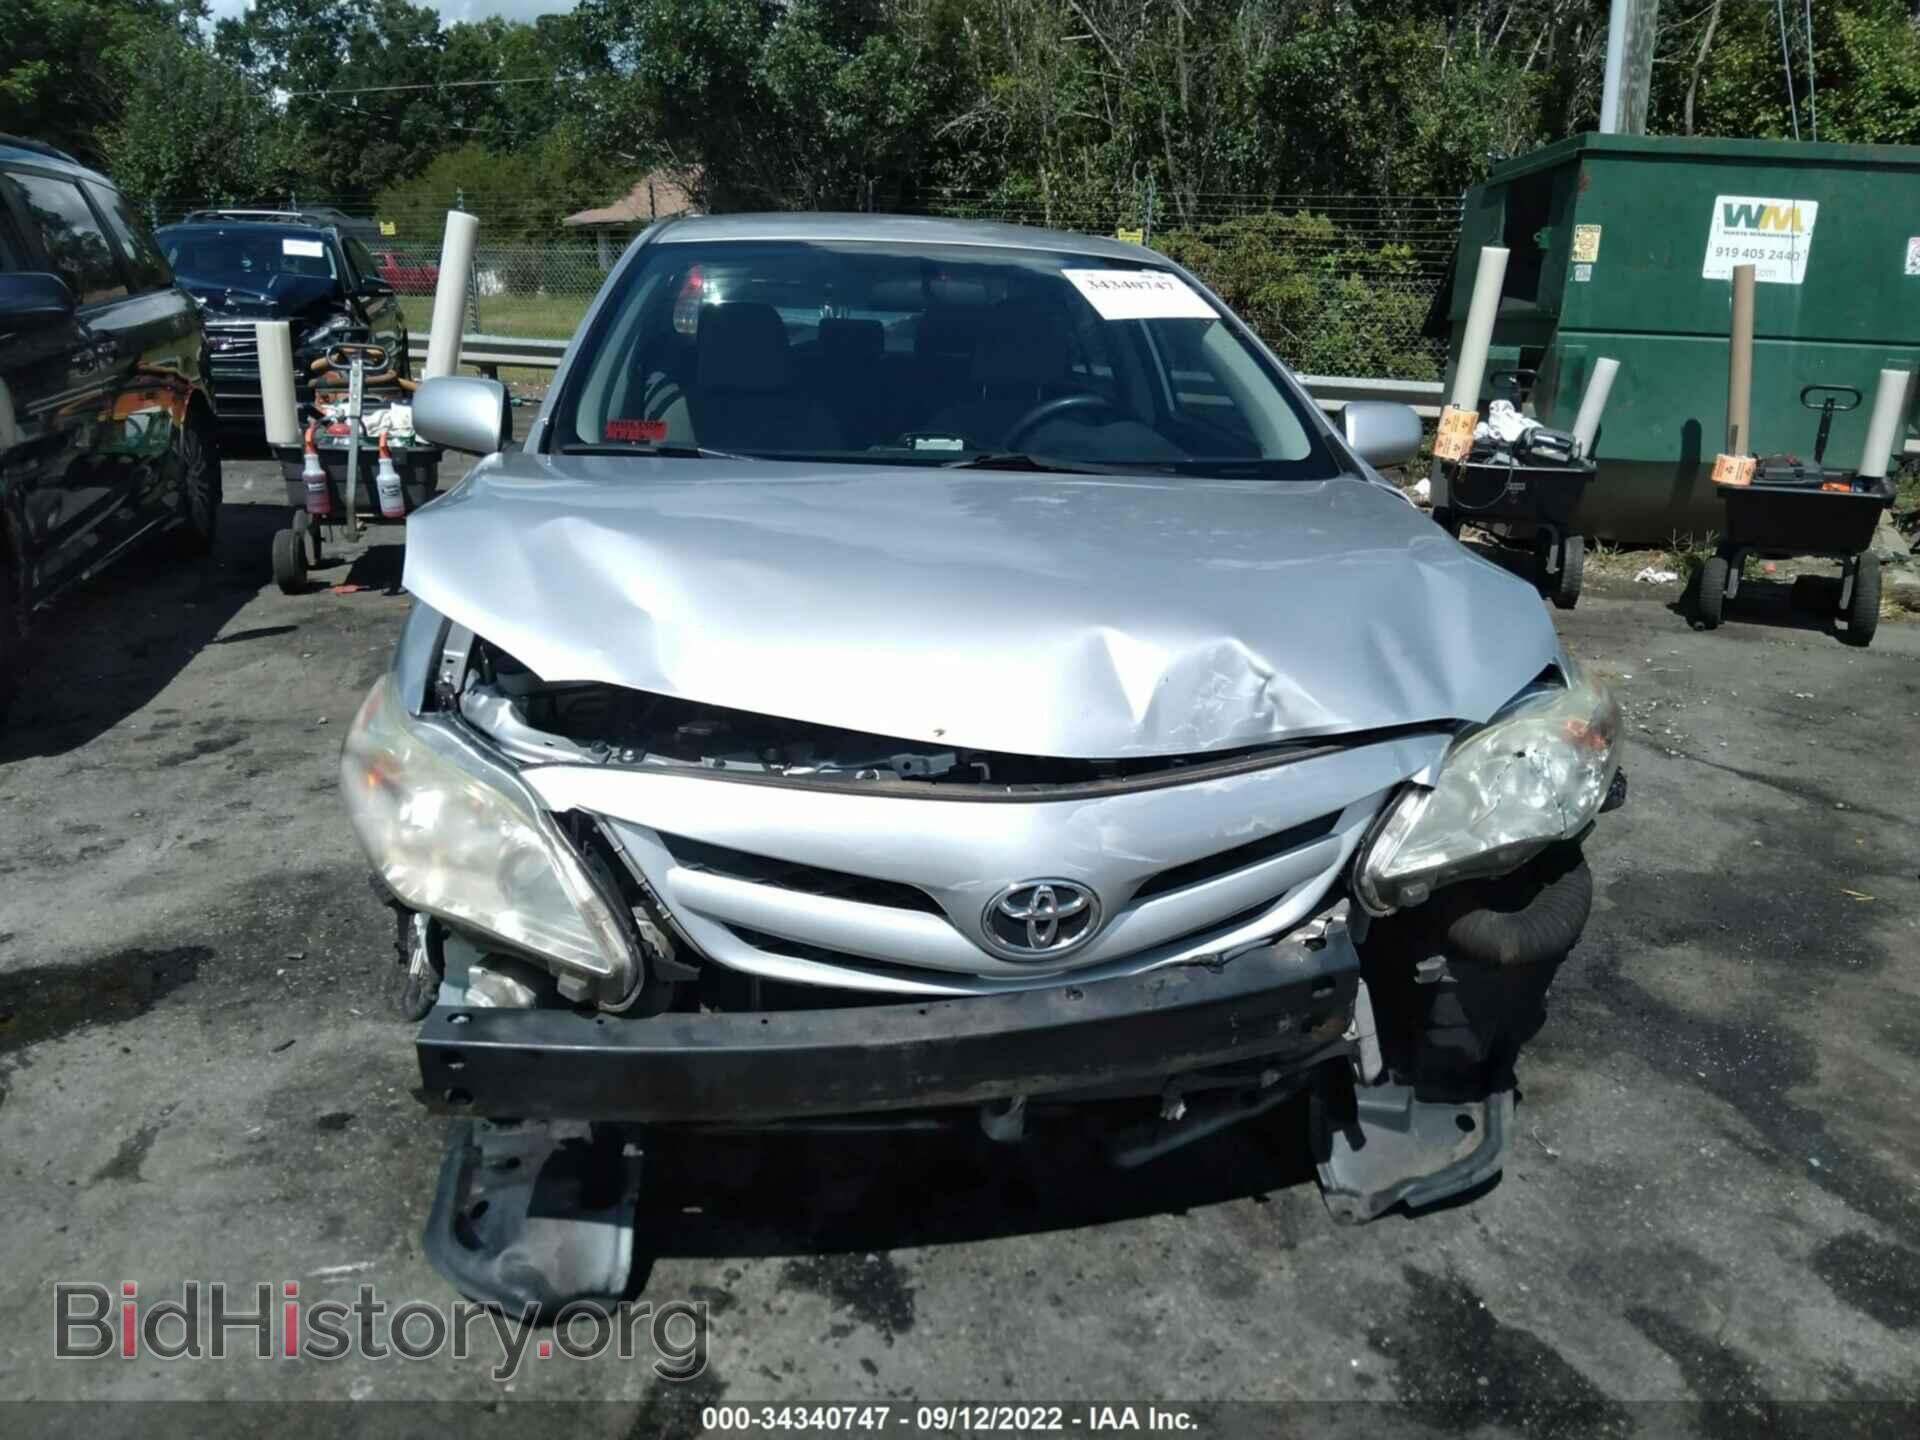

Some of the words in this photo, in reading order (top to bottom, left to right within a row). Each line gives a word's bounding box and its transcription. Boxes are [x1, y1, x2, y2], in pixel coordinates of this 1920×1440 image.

[1723, 203, 1804, 233] WM
[1715, 246, 1740, 258] 919
[1742, 248, 1765, 260] 405
[1767, 250, 1801, 262] 2440
